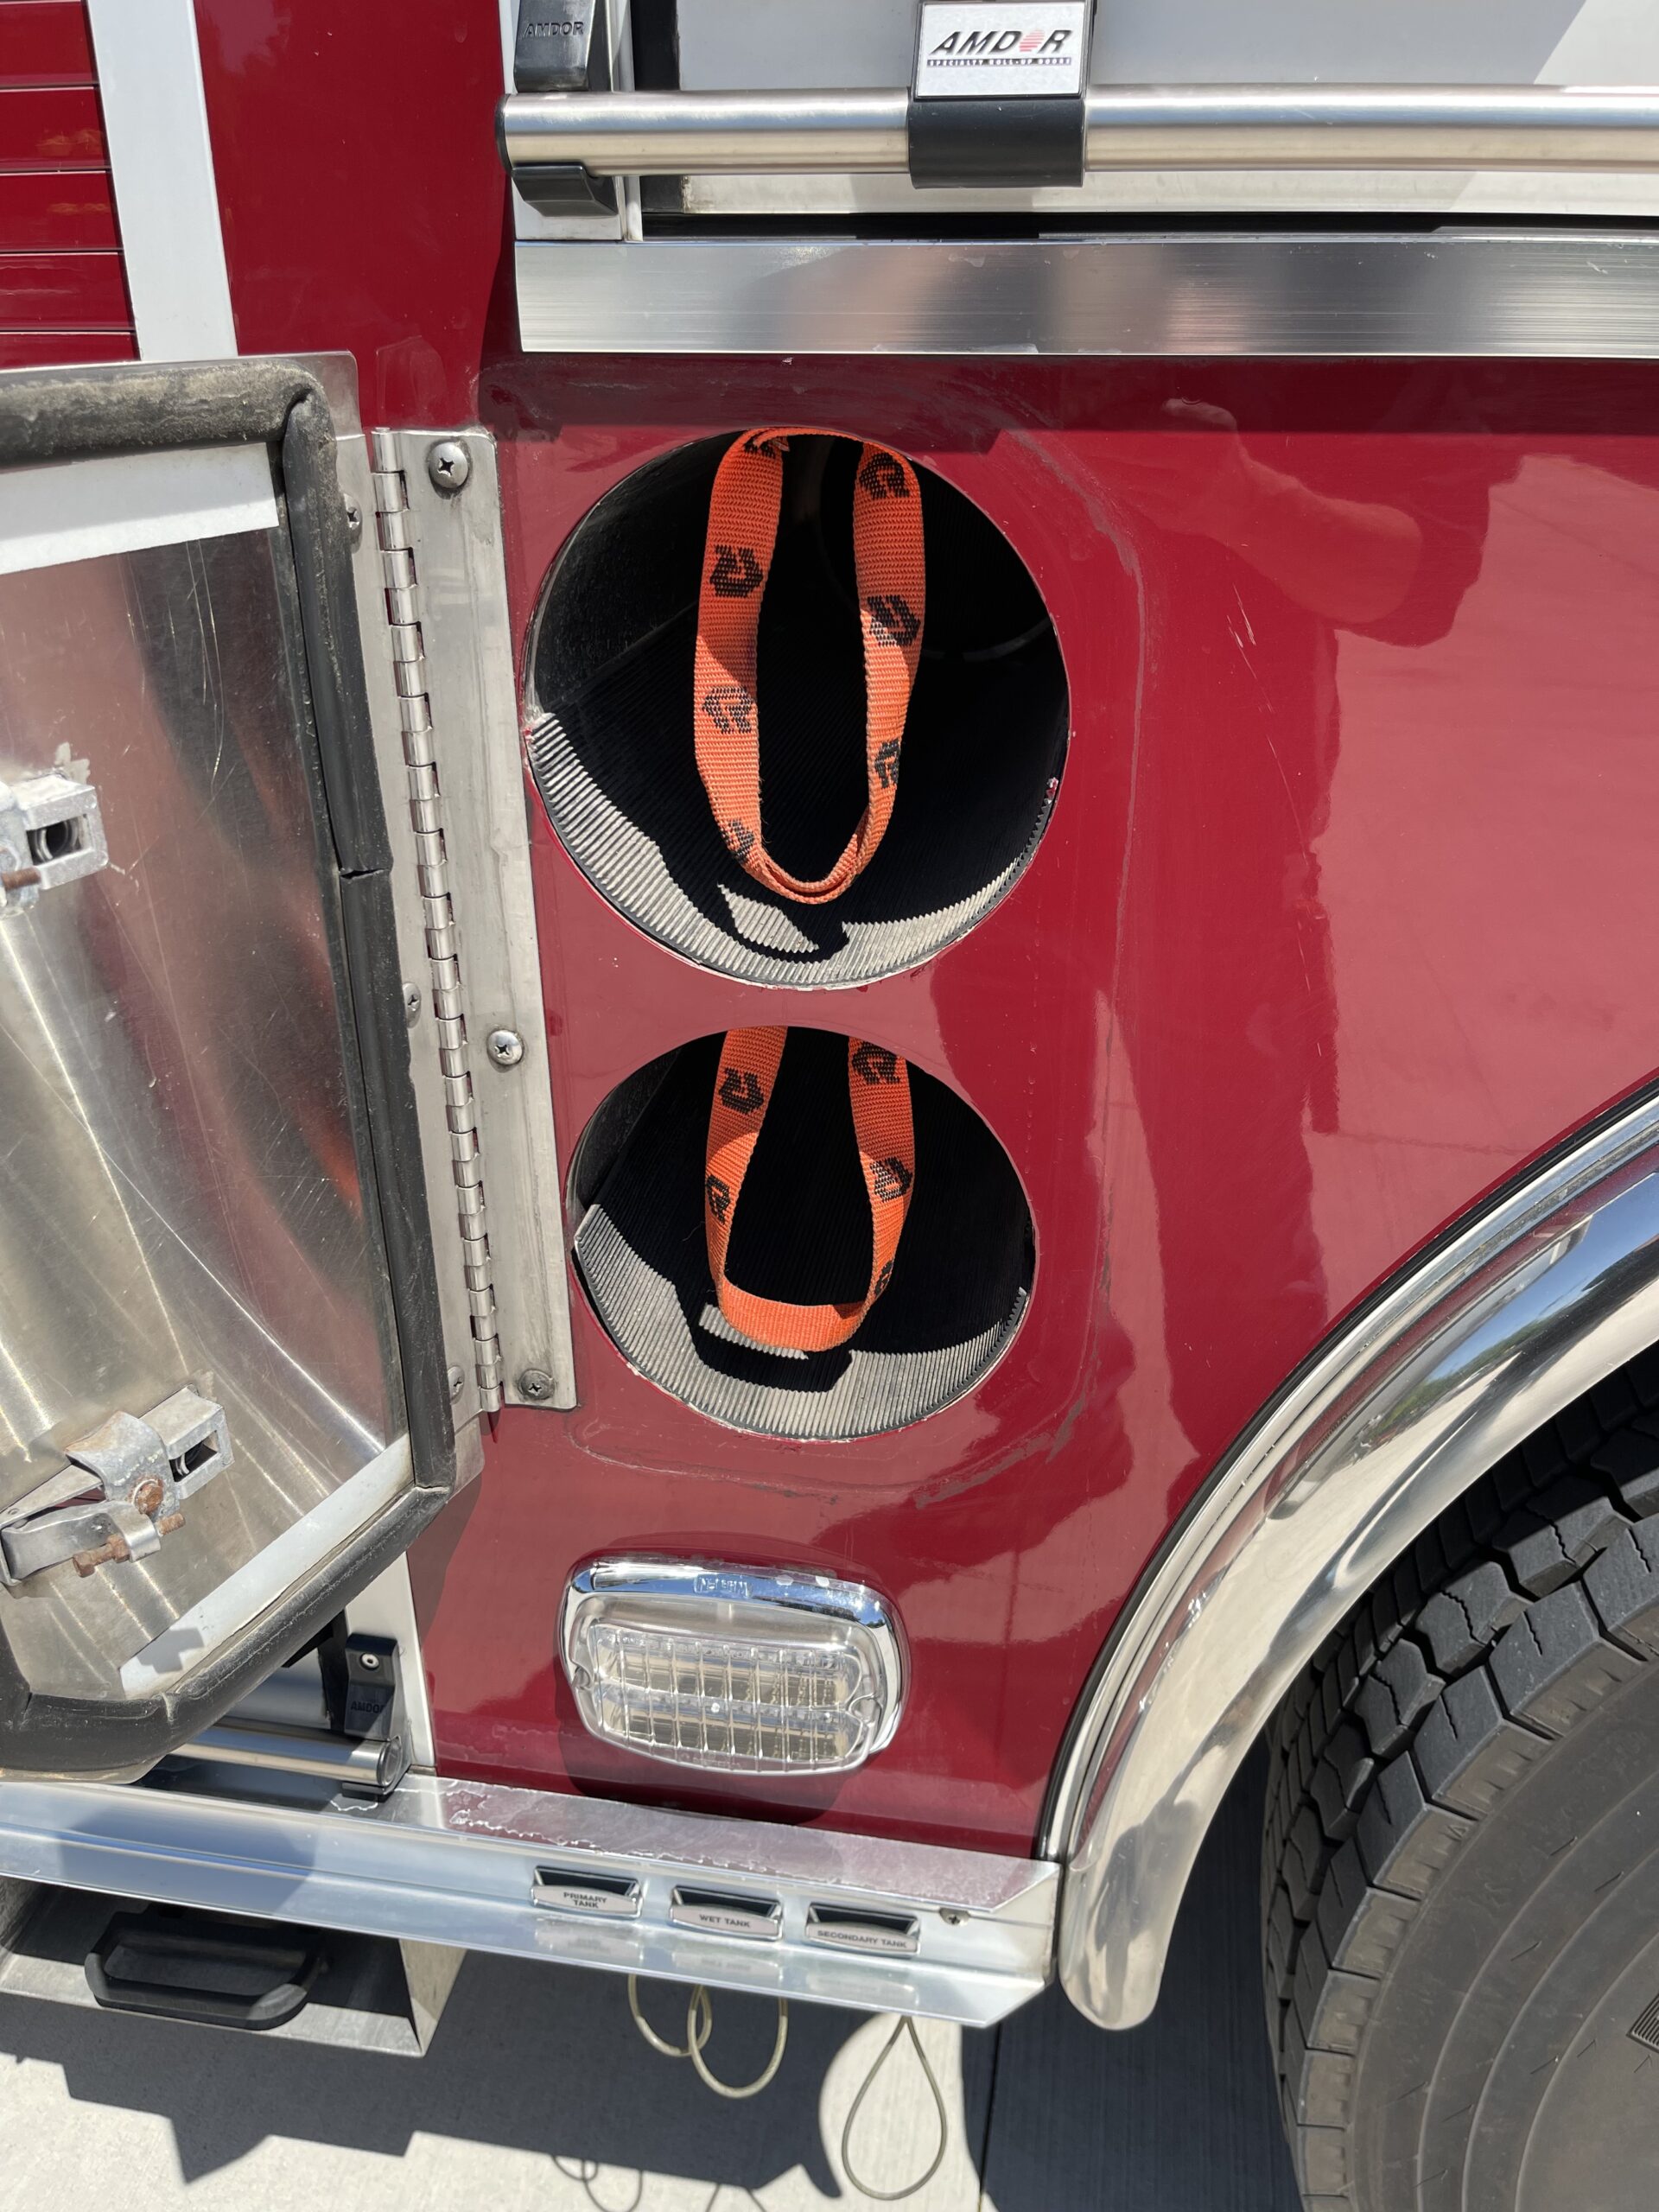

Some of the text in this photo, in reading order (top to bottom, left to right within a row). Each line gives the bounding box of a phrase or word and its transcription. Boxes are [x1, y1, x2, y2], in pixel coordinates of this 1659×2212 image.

[524, 22, 584, 37] AMDOR
[930, 29, 1073, 55] AMDOR
[930, 58, 984, 67] SPECIALTY
[563, 1891, 607, 1903] PRIMARY
[574, 1899, 599, 1909] TANK
[699, 1914, 750, 1928] WET TANK
[817, 1929, 906, 1948] SECONDARY TANK
